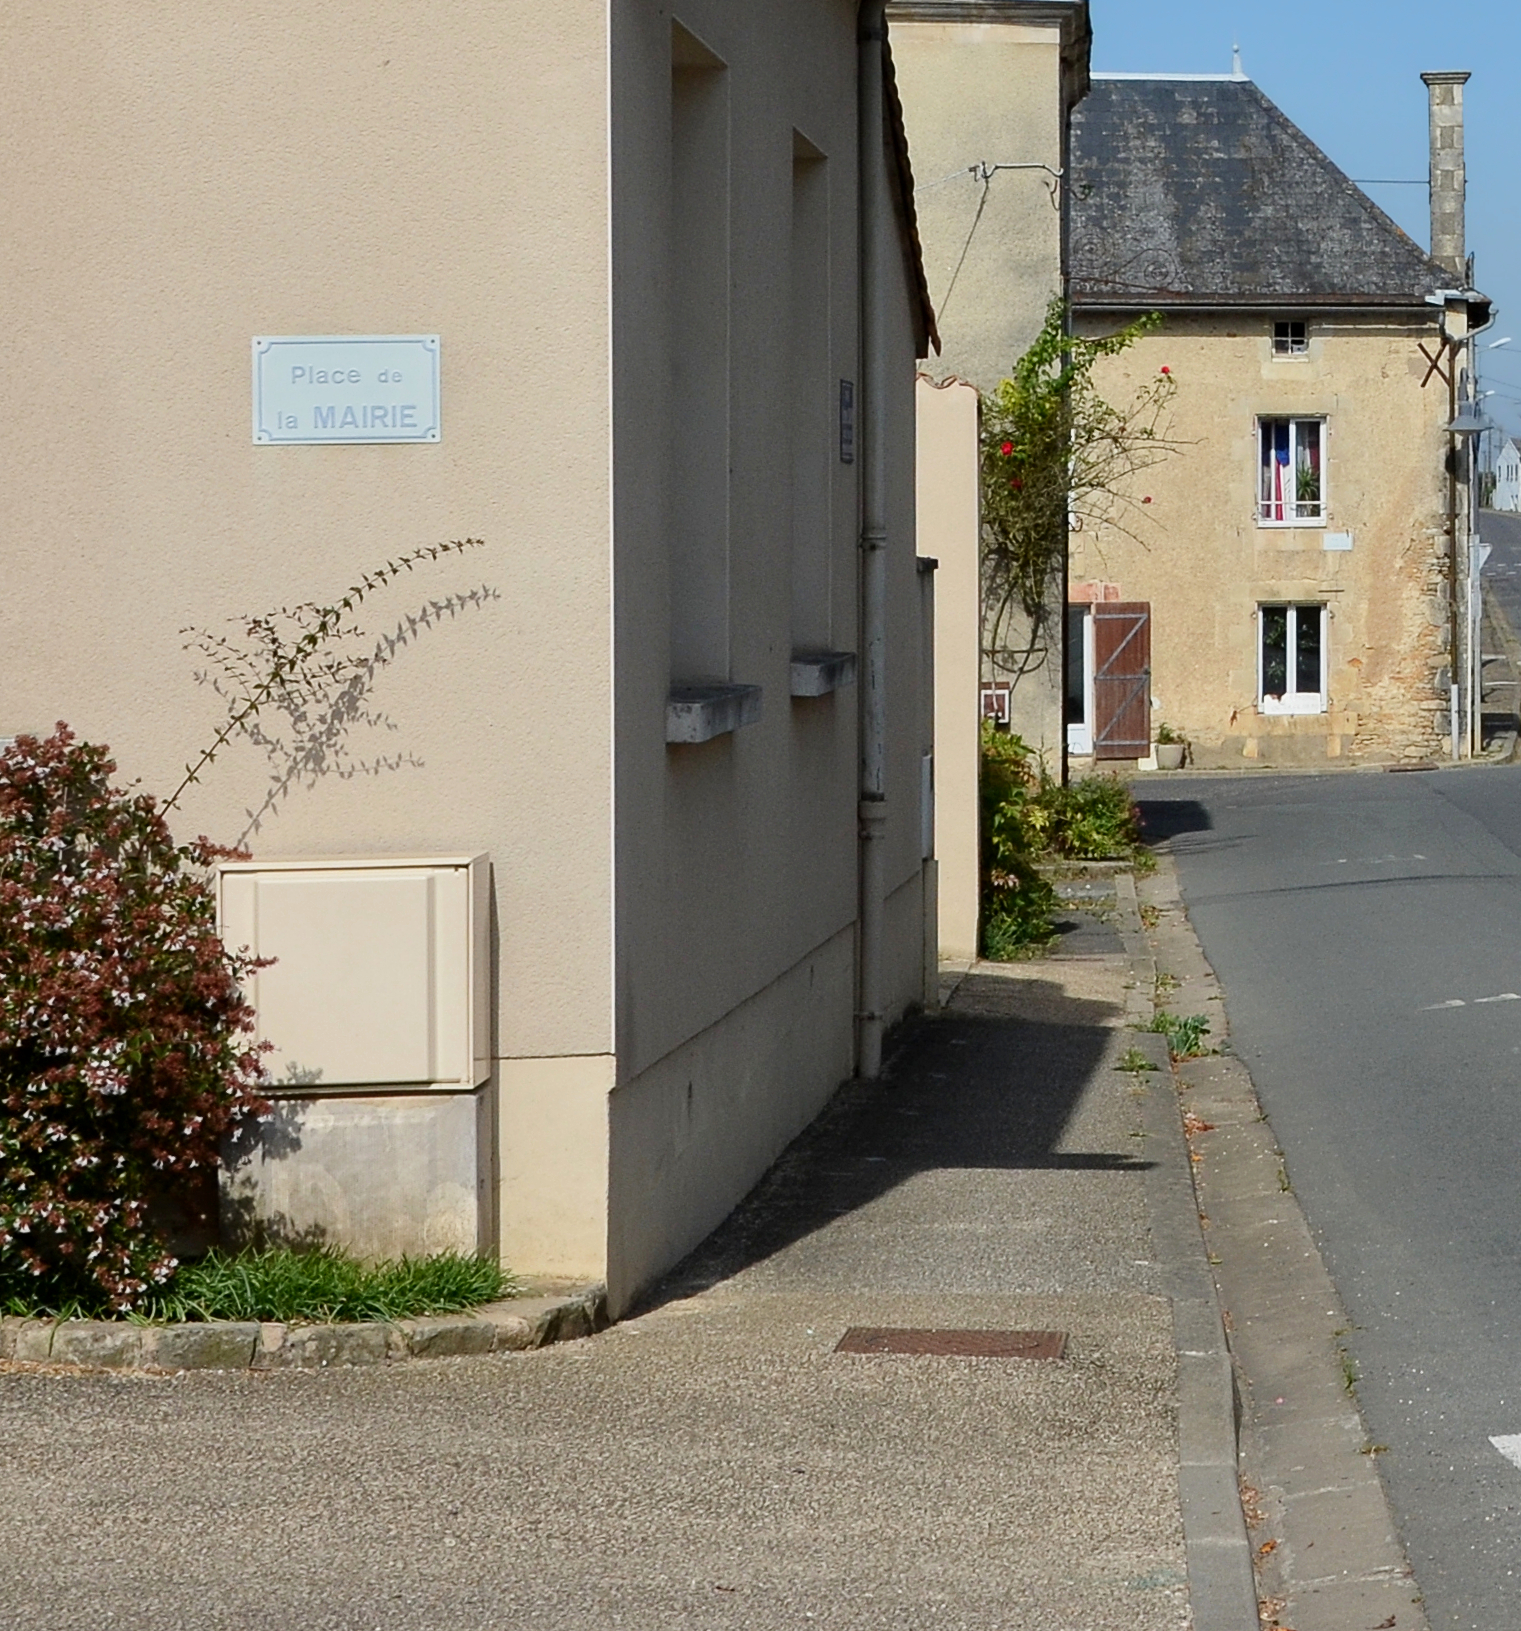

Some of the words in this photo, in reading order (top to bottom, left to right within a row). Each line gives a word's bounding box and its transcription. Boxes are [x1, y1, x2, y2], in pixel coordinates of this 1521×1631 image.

[291, 365, 361, 384] Place
[377, 367, 403, 383] de
[277, 410, 298, 429] la
[313, 405, 418, 429] MAIRIE
